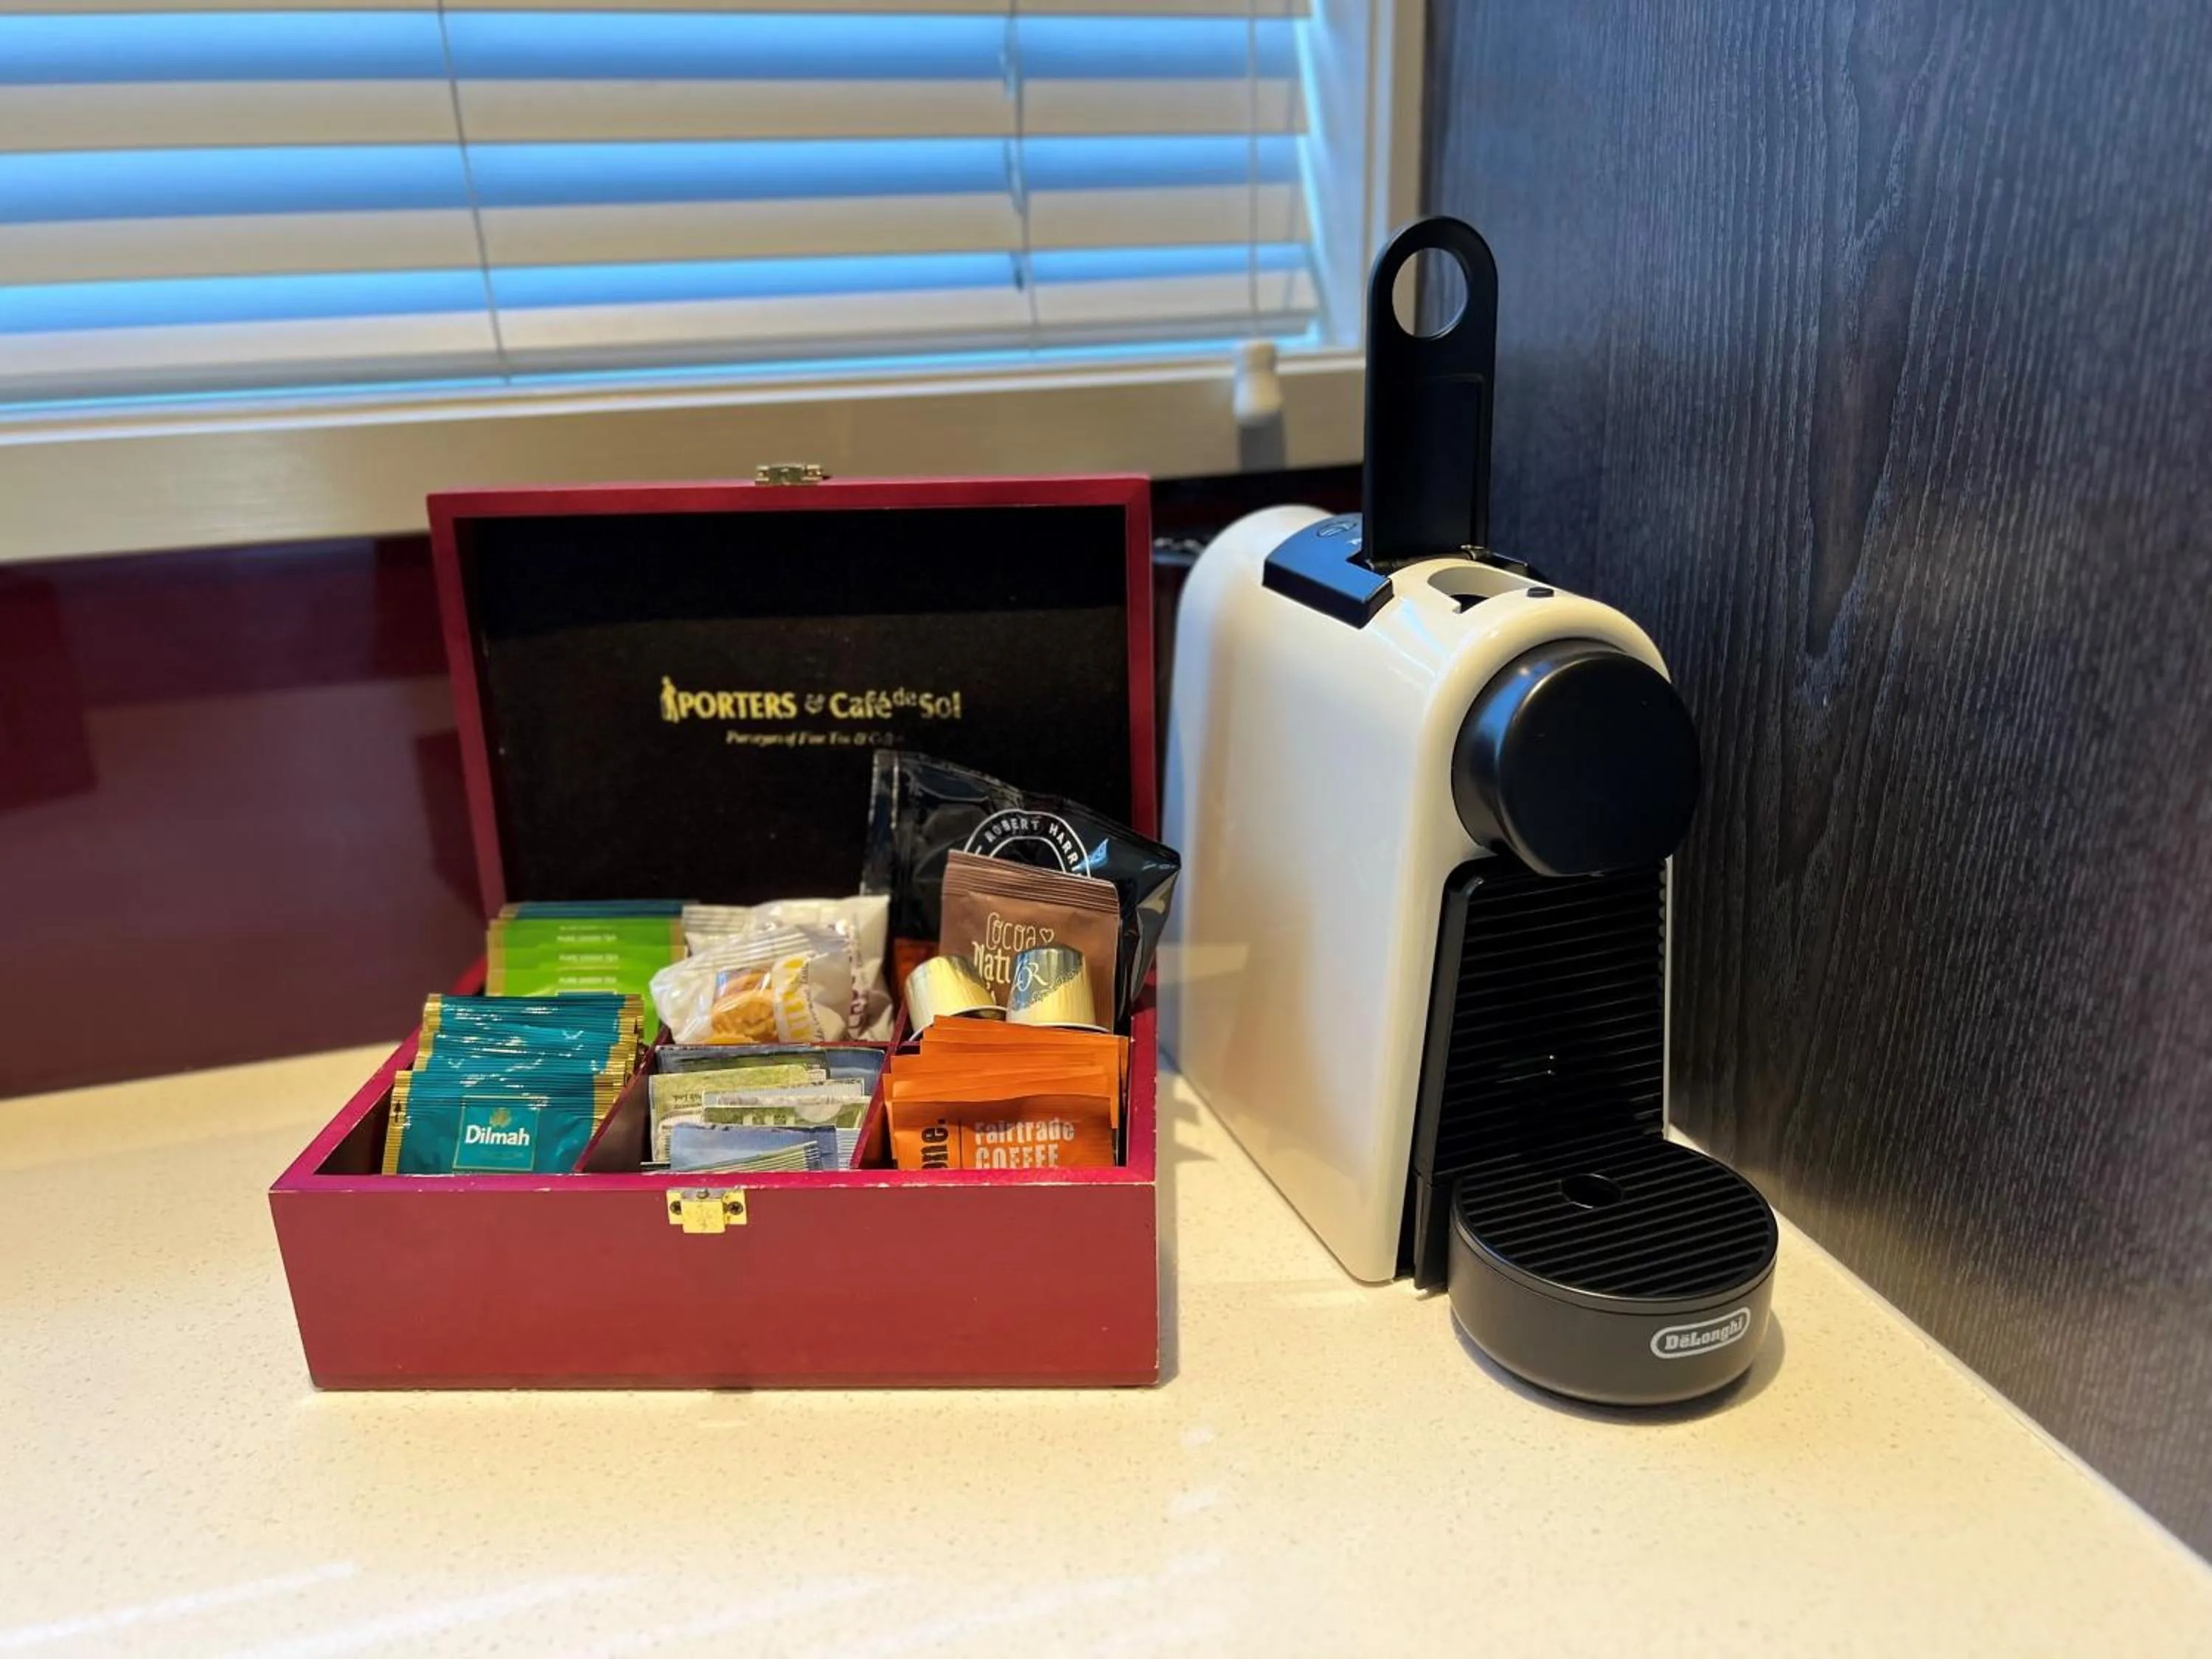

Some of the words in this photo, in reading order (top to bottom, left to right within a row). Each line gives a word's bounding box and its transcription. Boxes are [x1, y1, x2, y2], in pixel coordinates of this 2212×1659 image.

[680, 692, 798, 720] PORTERS
[804, 693, 826, 714] &
[830, 690, 891, 720] Café
[892, 686, 917, 707] de
[919, 691, 962, 720] Sol
[984, 817, 1040, 844] ROBERT
[986, 911, 1036, 952] Cocoa
[464, 1124, 531, 1147] Dilmah
[974, 1143, 1060, 1169] COFFEE
